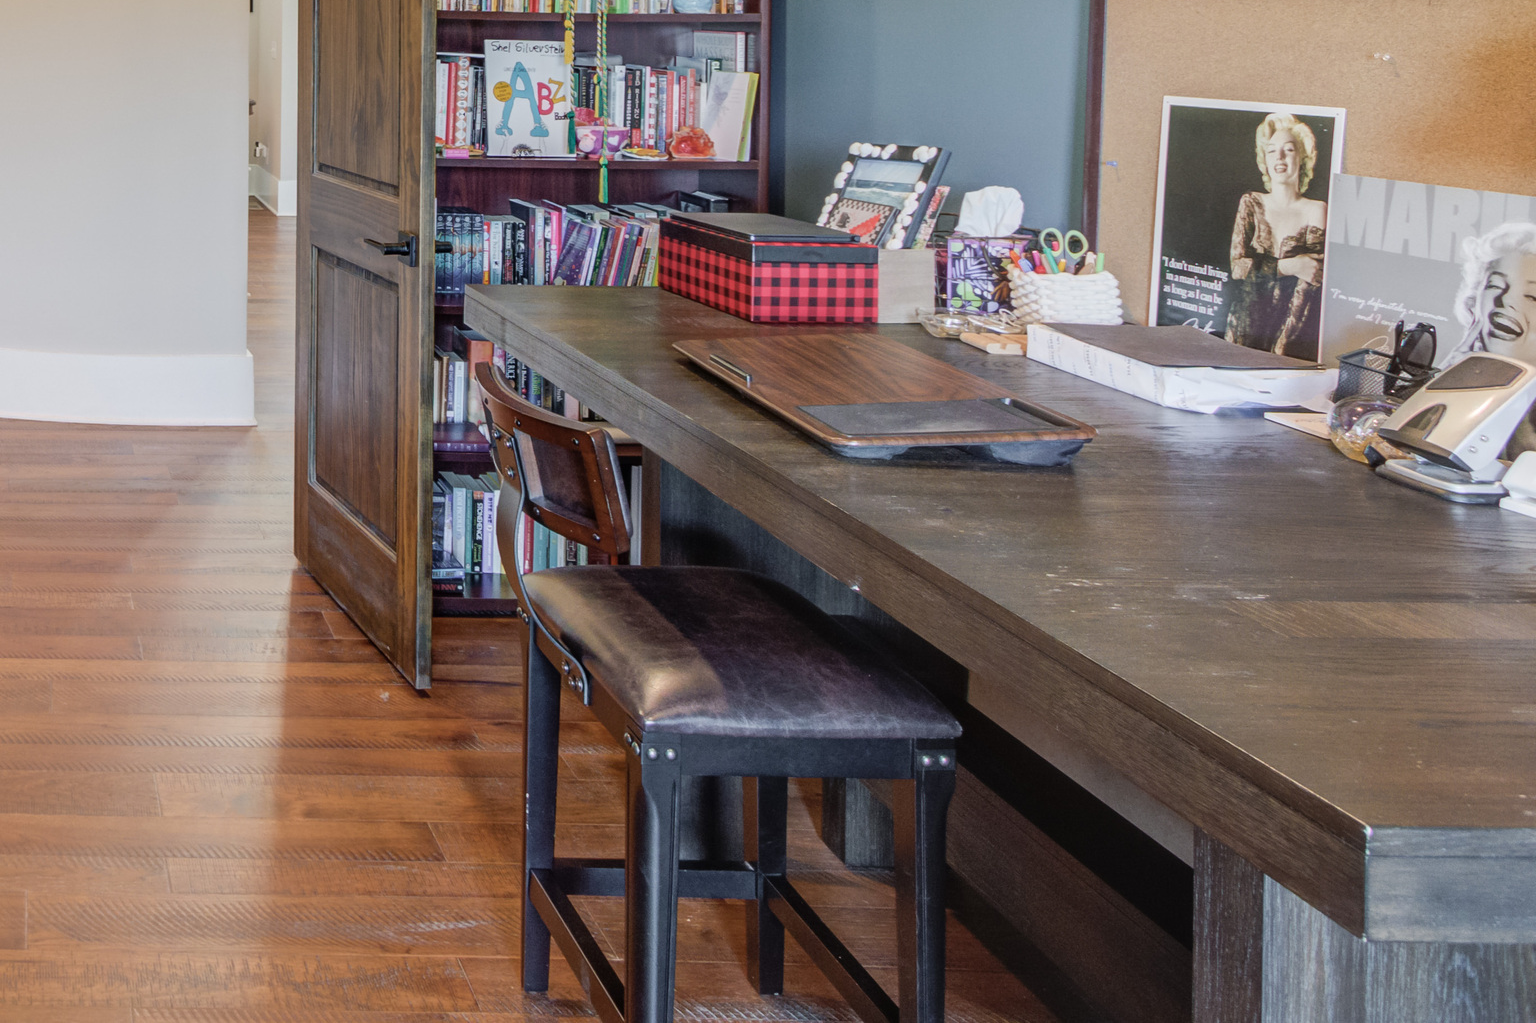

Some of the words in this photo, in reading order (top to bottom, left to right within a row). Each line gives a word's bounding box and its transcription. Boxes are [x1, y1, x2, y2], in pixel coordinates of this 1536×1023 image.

[491, 41, 511, 52] Shel
[1165, 269, 1174, 280] in
[1173, 274, 1179, 282] a
[1179, 275, 1200, 286] man's
[1200, 279, 1222, 291] world
[1168, 257, 1188, 271] don't
[1187, 262, 1207, 275] mind
[1207, 265, 1229, 282] living
[1163, 284, 1171, 292] as
[1171, 283, 1187, 299] long
[1187, 290, 1195, 298] as
[1195, 289, 1200, 299] I
[1200, 293, 1213, 302] can
[1213, 293, 1223, 304] be
[1171, 299, 1198, 312] woman
[1198, 302, 1207, 314] in
[1348, 296, 1366, 310] very
[1366, 297, 1407, 318] definitely
